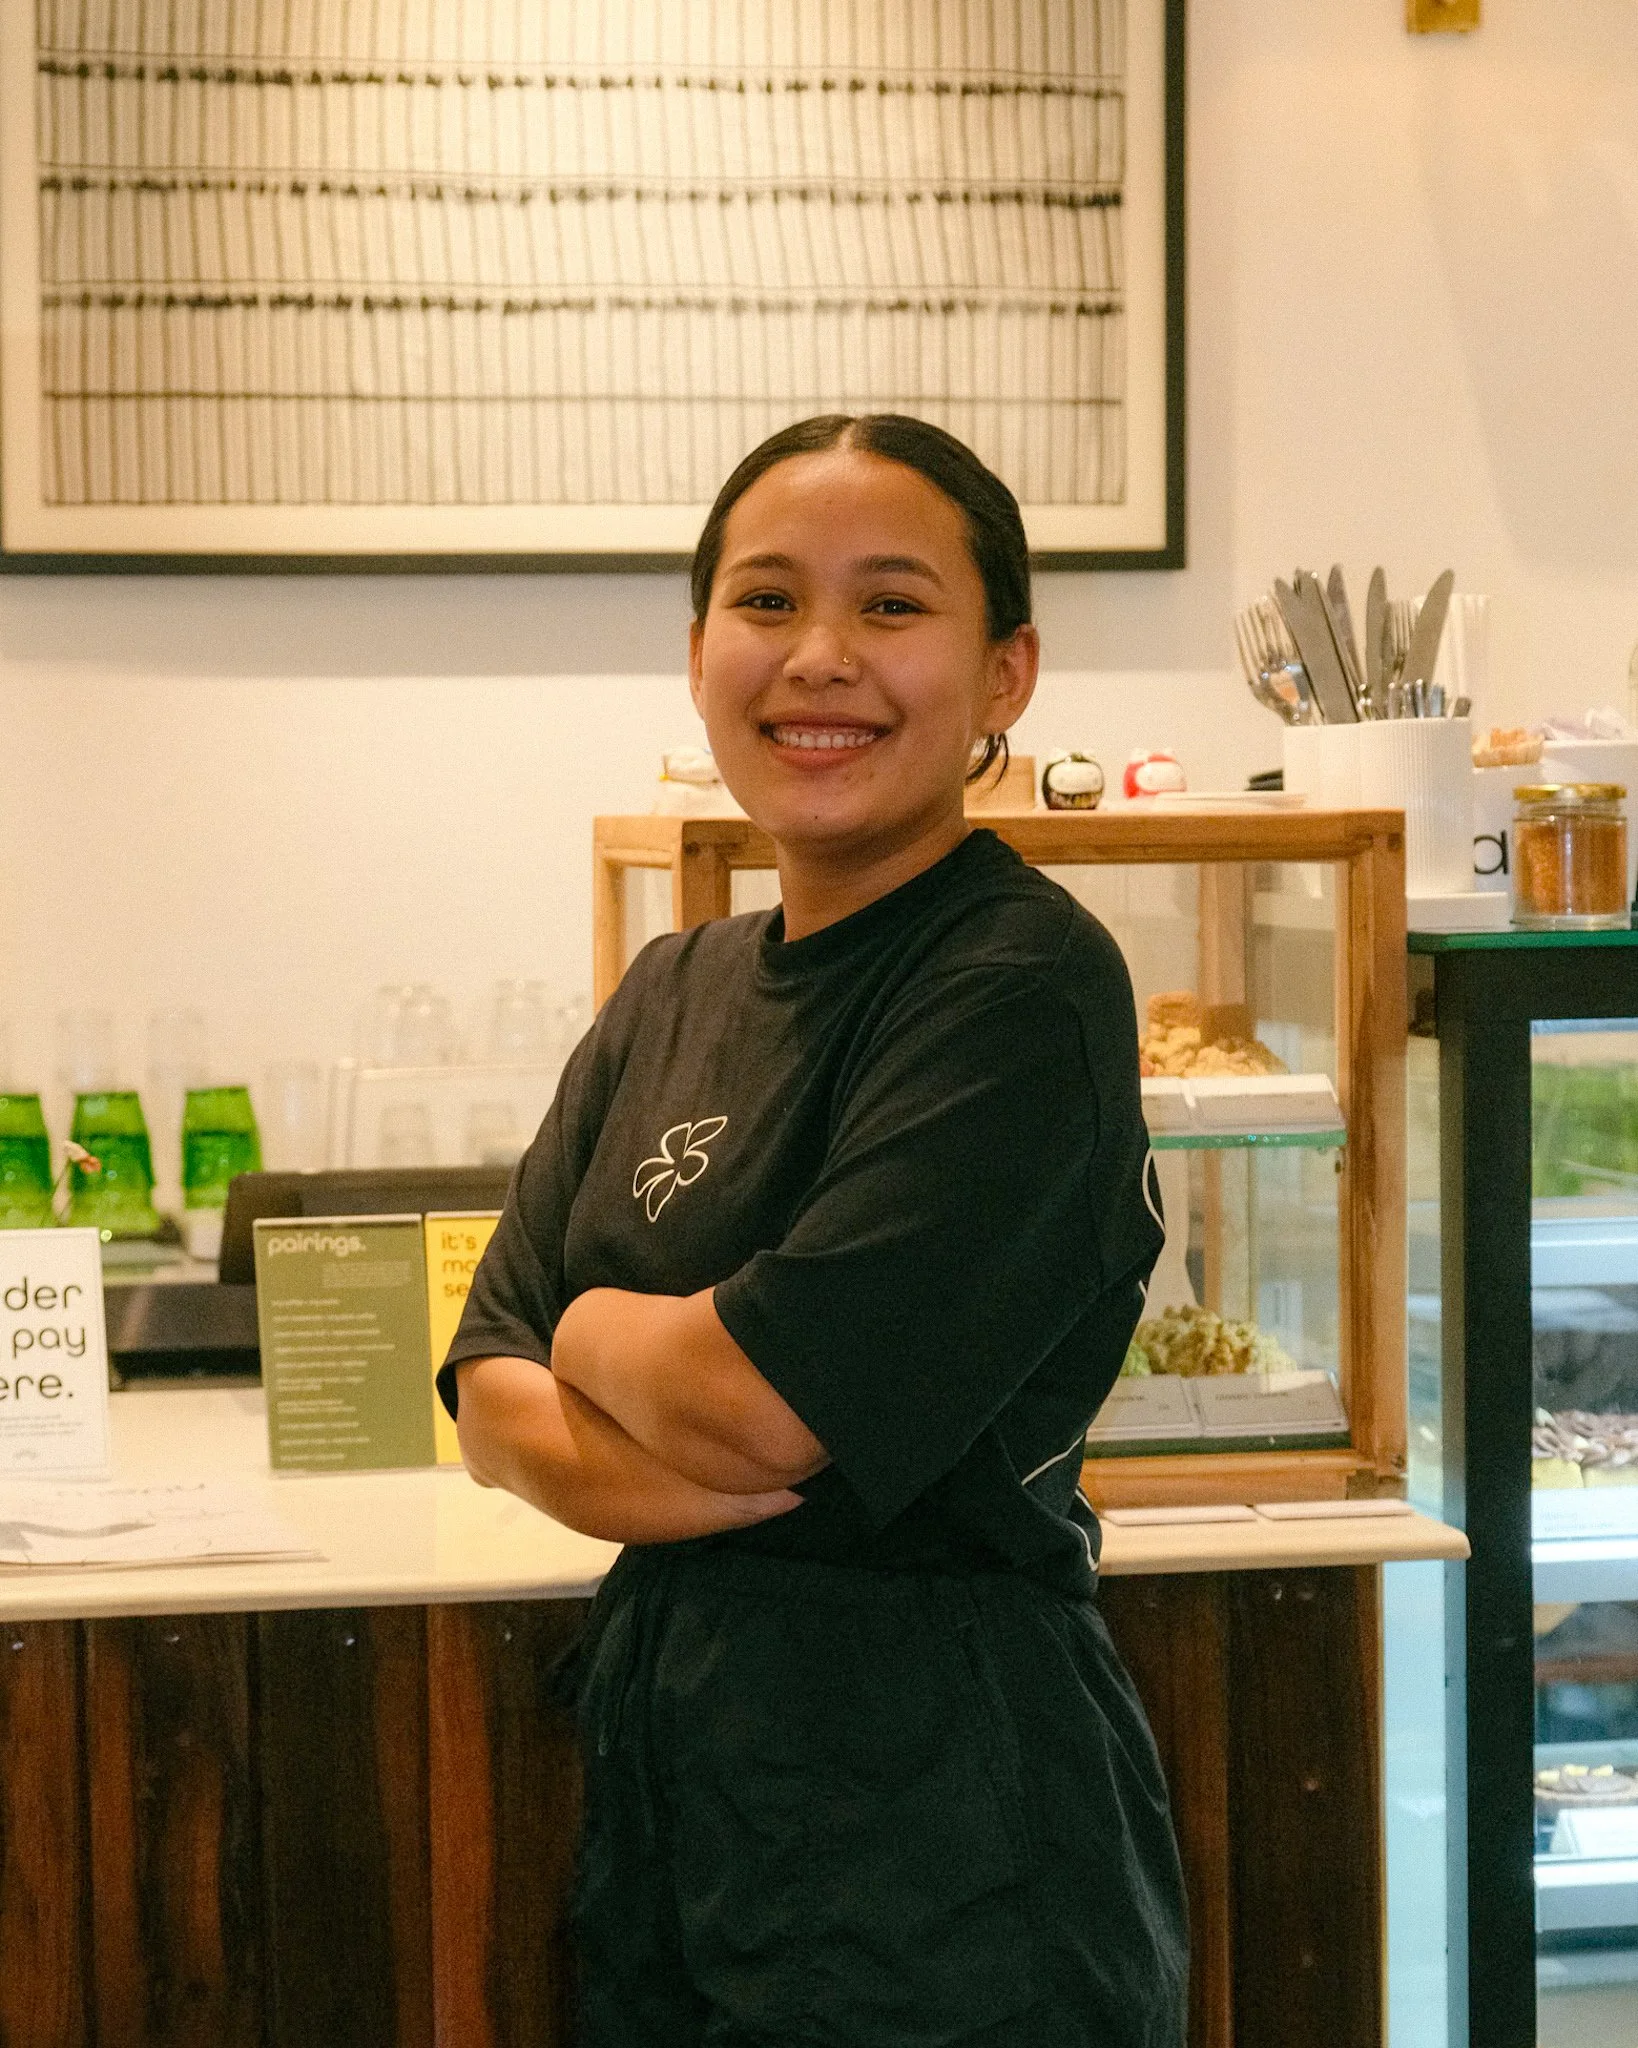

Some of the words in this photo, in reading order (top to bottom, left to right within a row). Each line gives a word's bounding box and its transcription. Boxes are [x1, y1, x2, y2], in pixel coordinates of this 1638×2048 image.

[267, 1231, 366, 1258] pairings.
[442, 1231, 476, 1251] it's
[5, 1276, 82, 1311] der
[13, 1327, 86, 1360] pay
